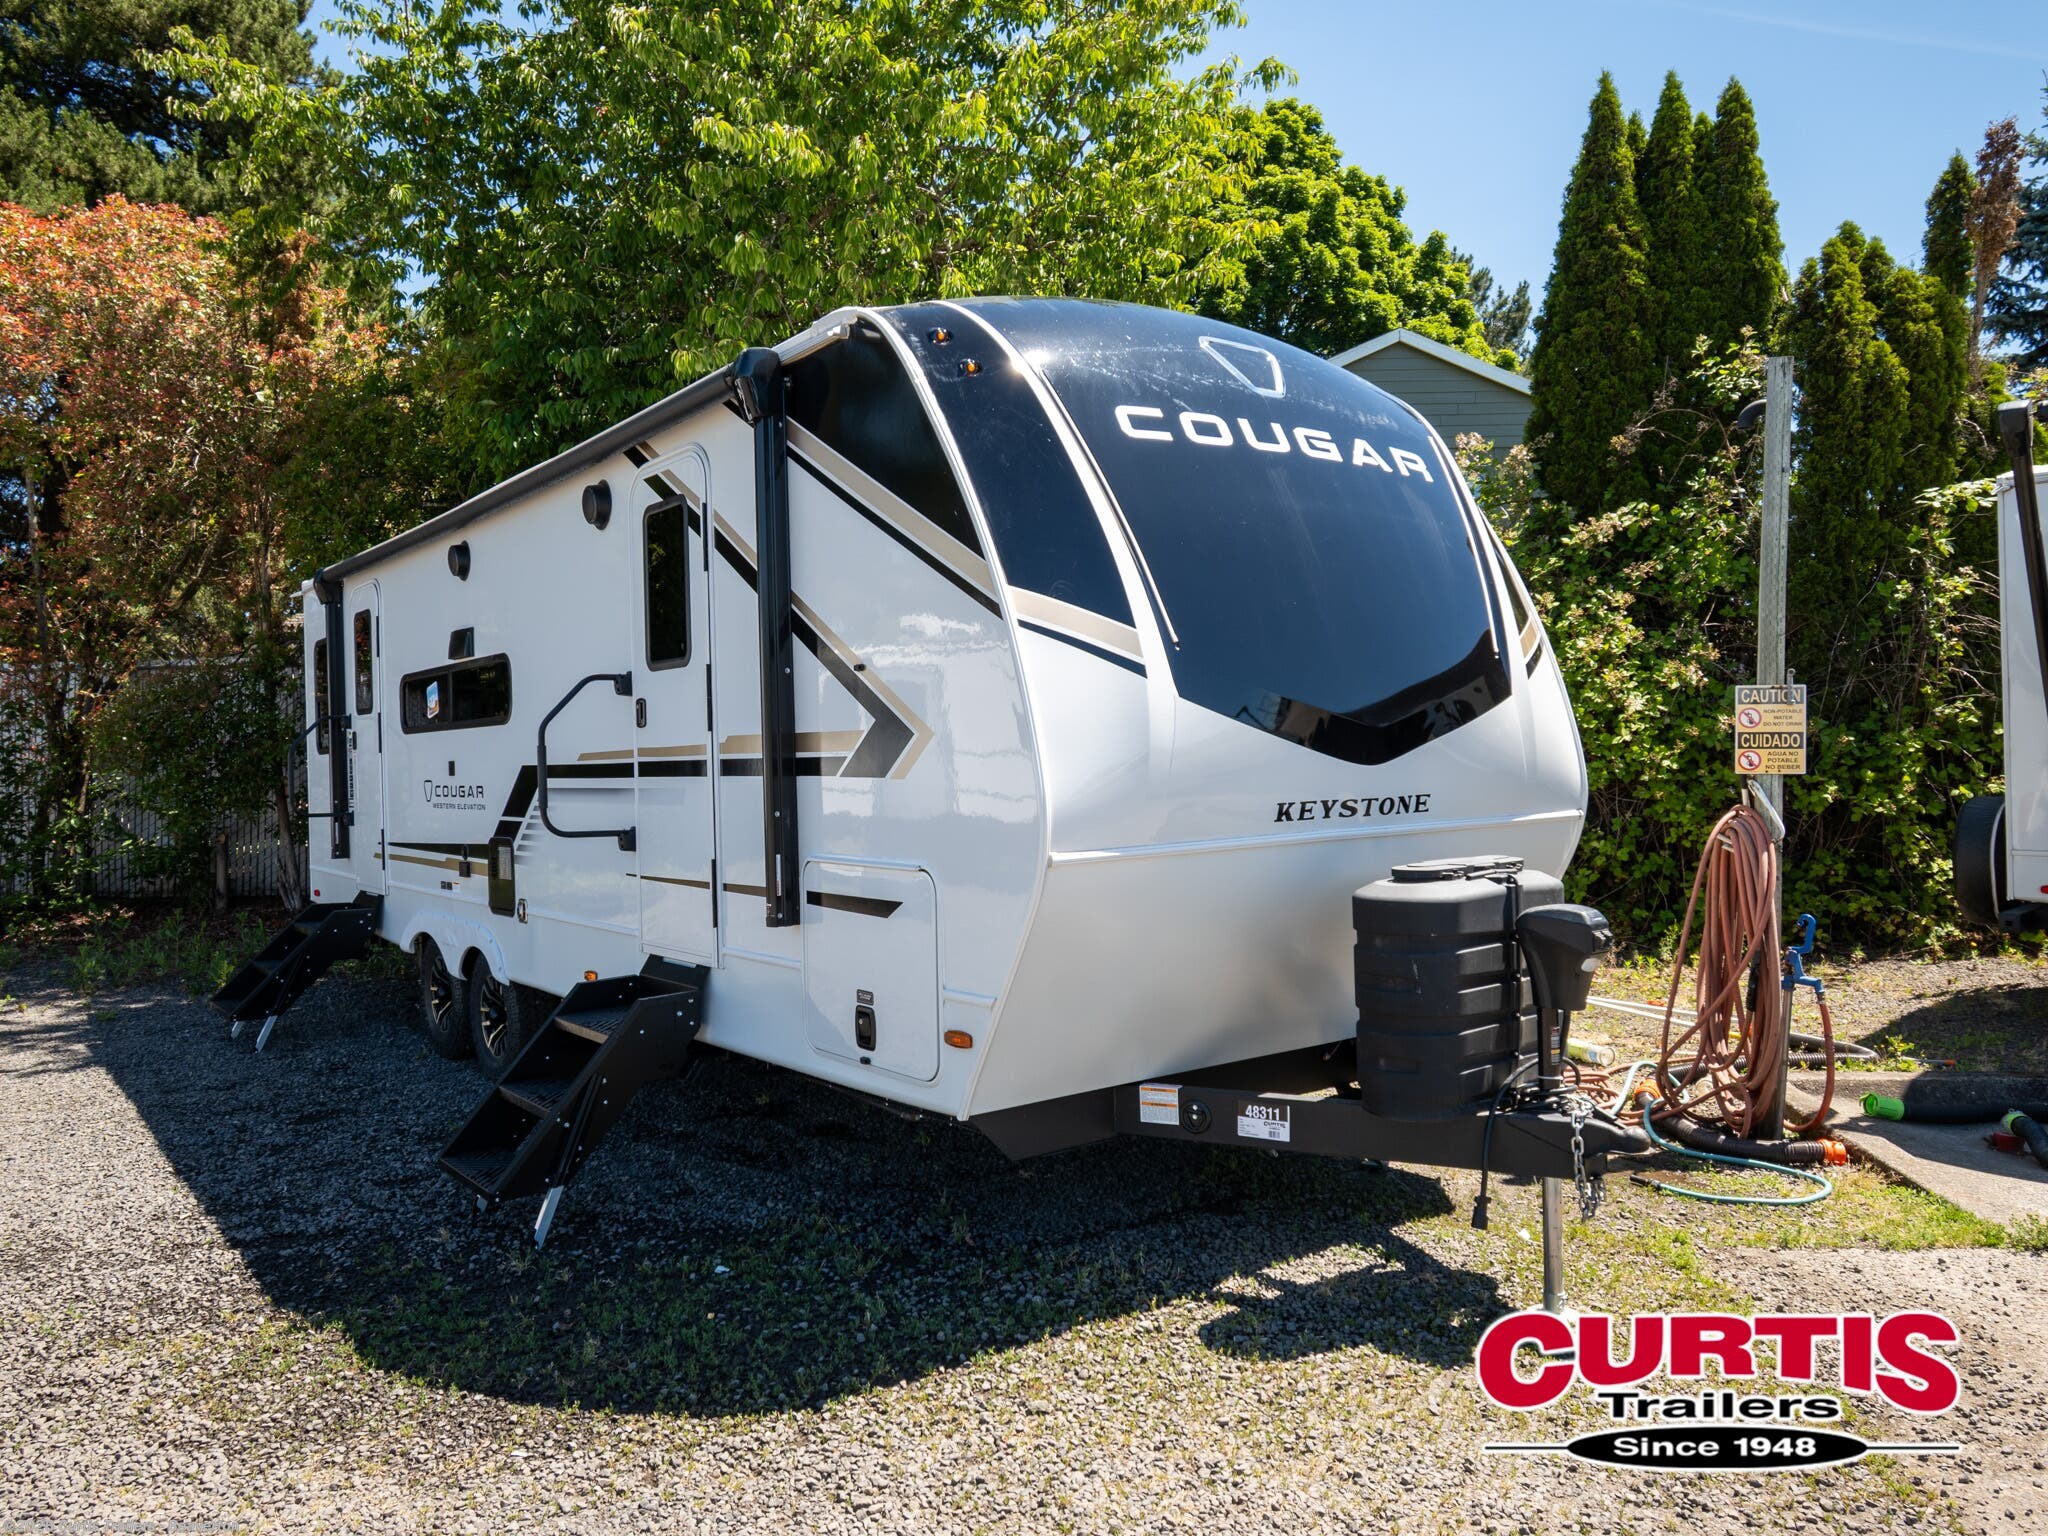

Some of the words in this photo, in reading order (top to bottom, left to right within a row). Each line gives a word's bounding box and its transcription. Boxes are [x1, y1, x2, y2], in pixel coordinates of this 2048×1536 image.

[1114, 404, 1435, 483] COUGAR
[1741, 734, 1800, 748] CUIDADO
[435, 785, 484, 798] COUGAR
[1273, 794, 1432, 823] KEYSTONE
[1245, 1104, 1280, 1121] 48311
